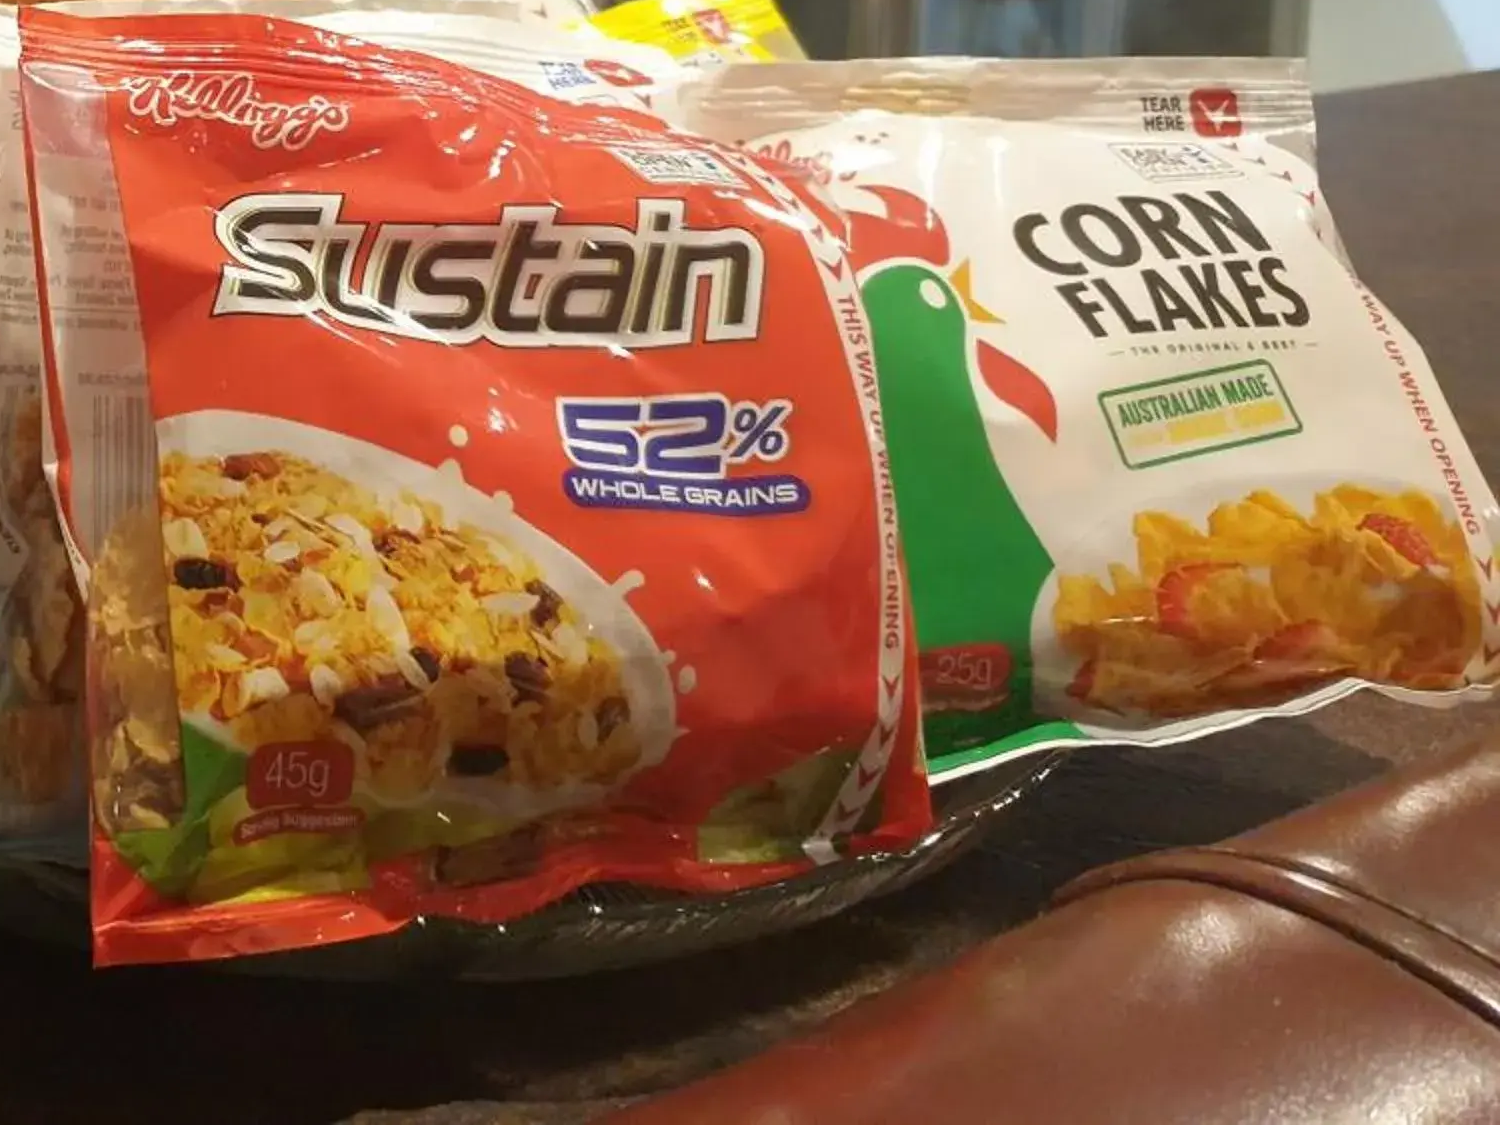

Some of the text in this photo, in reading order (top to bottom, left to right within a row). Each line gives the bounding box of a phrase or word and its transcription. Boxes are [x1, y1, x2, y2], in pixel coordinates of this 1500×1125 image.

[122, 70, 349, 151] Kellogg's
[1140, 95, 1183, 113] TEAR
[1142, 115, 1185, 132] HERE
[212, 194, 765, 348] Sustain
[1012, 190, 1272, 276] CORN
[1054, 257, 1311, 338] FLAKES
[838, 294, 868, 346] THIS
[854, 350, 878, 403] WAY
[556, 393, 793, 479] 52%
[1117, 383, 1222, 428] AUSTRALIAN
[1219, 374, 1274, 405] MADE
[1361, 294, 1392, 337] WAY
[1383, 339, 1407, 370] UP
[1398, 369, 1439, 433] WHEN
[1429, 436, 1481, 536] OPENING
[571, 476, 800, 508] WHOLE GRAINS
[264, 751, 330, 798] 45g
